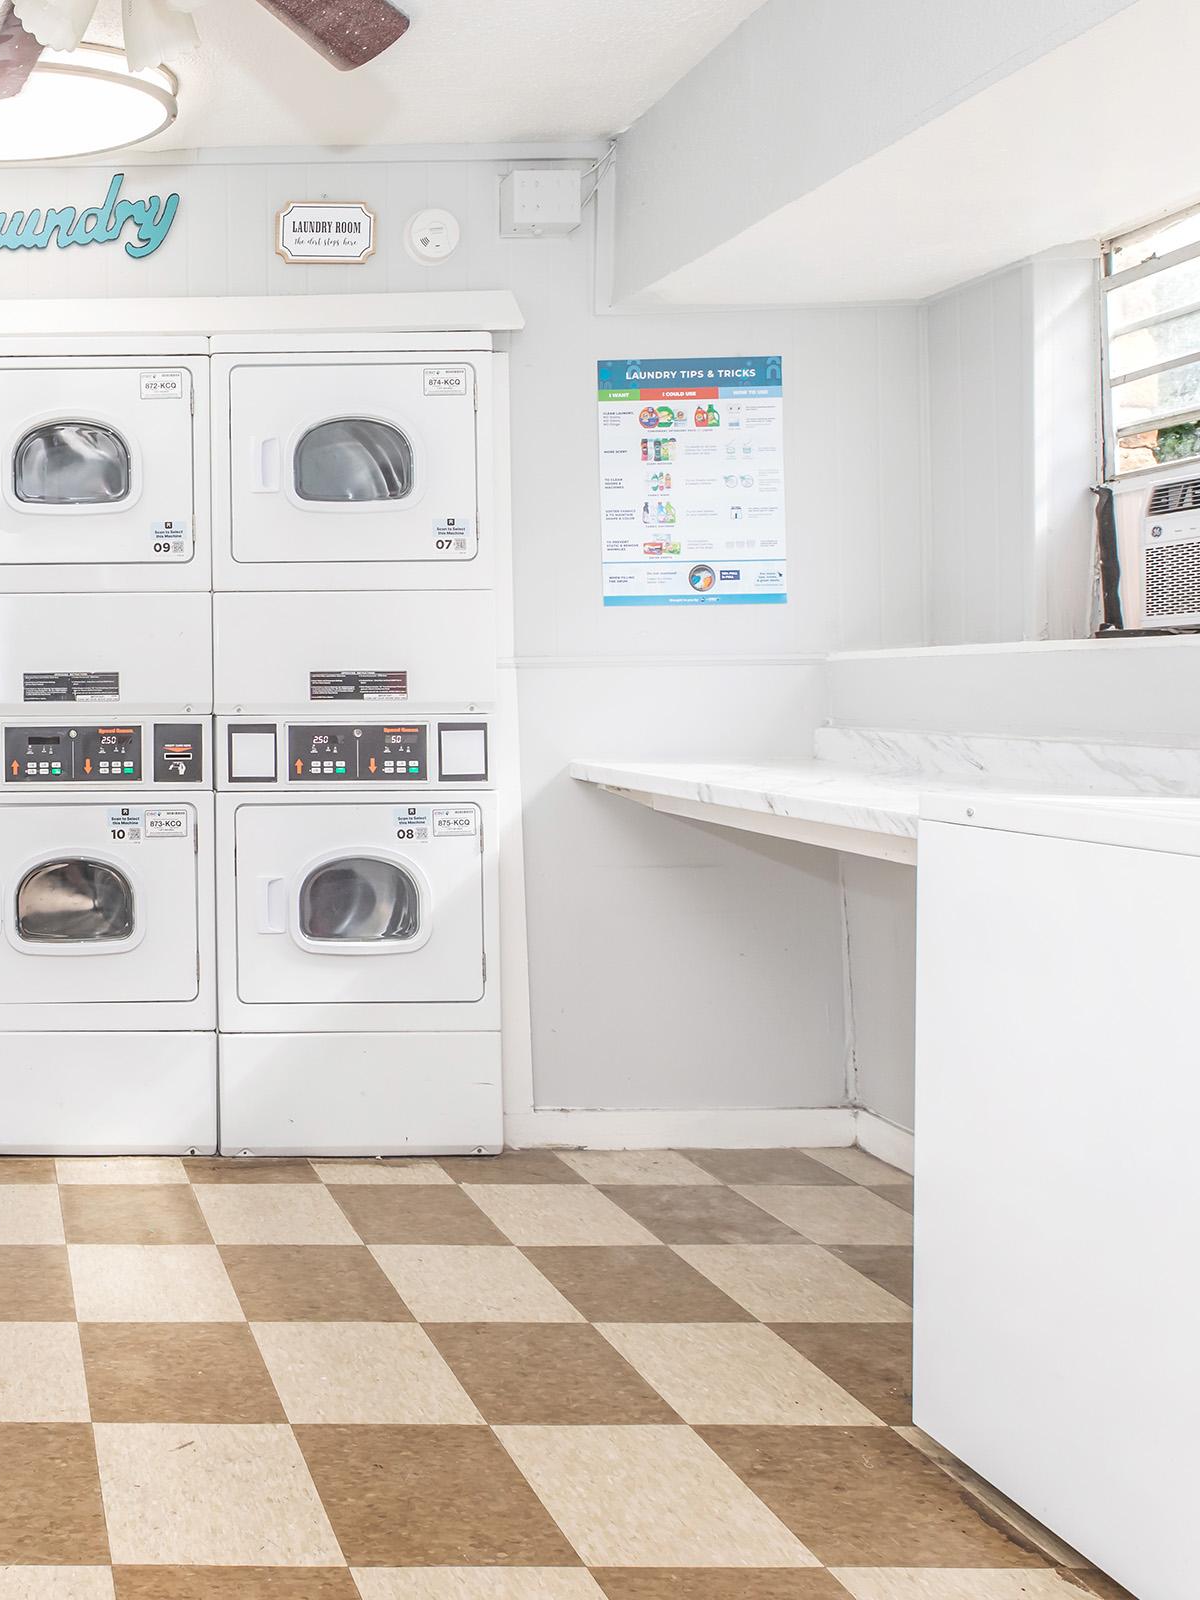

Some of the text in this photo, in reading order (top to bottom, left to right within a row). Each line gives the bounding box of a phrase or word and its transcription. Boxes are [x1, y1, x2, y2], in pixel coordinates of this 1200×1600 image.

[292, 221, 361, 234] LAUNDRY ROOM
[294, 237, 304, 245] the
[626, 369, 756, 380] LAUNDRY TIPS & TRICKS
[153, 542, 170, 552] 09
[436, 539, 452, 550] 07
[111, 829, 125, 839] 10
[397, 829, 414, 839] 08
